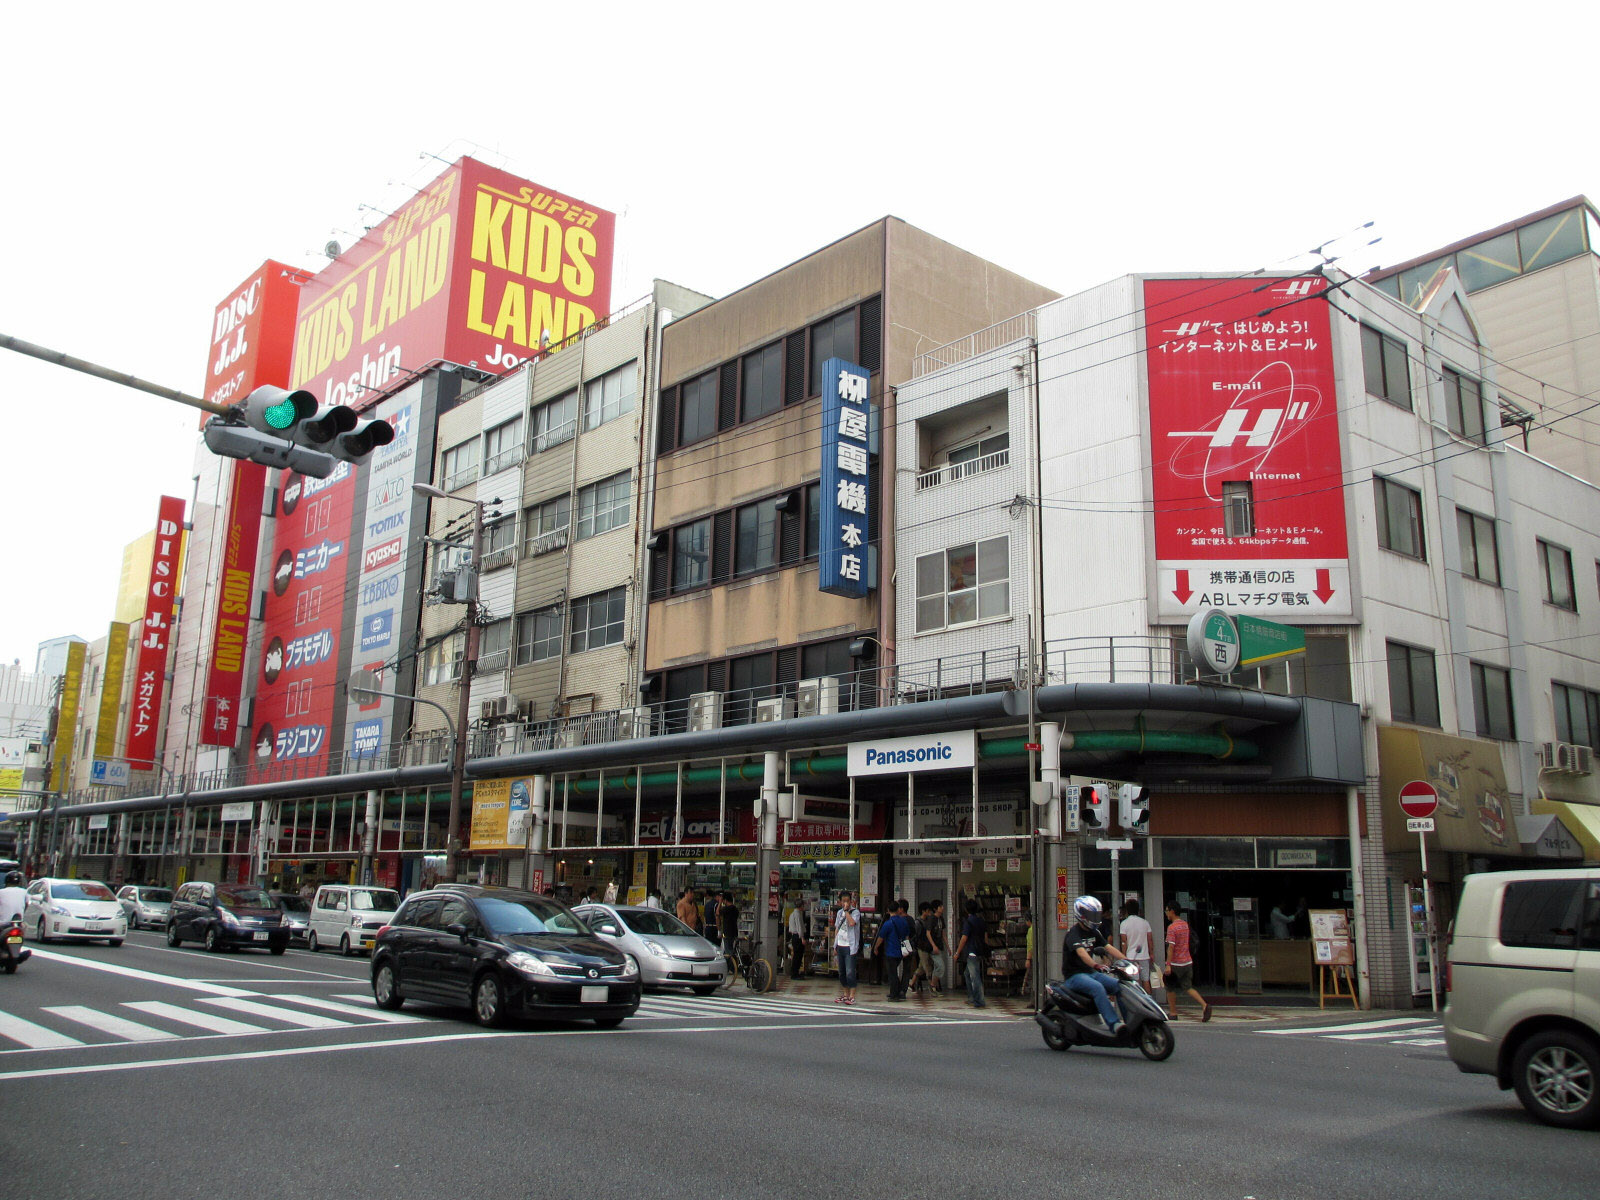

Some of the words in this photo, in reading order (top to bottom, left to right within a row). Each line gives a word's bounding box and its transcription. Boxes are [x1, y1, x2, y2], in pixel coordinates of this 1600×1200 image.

[518, 186, 599, 229] SUPER
[470, 189, 598, 298] KIDS
[212, 276, 262, 346] DISC
[291, 281, 359, 392] KIDS
[360, 212, 452, 346] LAND
[466, 267, 597, 355] LAND
[213, 324, 248, 376] J.J.
[1212, 381, 1262, 391] E-mail
[374, 477, 406, 507] KATO
[1249, 471, 1301, 481] Internet
[369, 510, 406, 538] TOMIX
[152, 519, 178, 598] DISC
[293, 542, 342, 577] ミニカー
[221, 568, 251, 616] KIDS
[363, 573, 399, 606] EBBRO
[1209, 570, 1295, 585] 携帯通信の店
[1199, 591, 1310, 607] ABLマチダ電気
[215, 617, 246, 673] LAND
[285, 630, 332, 670] プラモデル
[1214, 643, 1227, 664] 西
[134, 670, 155, 737] メガストア
[212, 696, 232, 732] 本店
[276, 726, 324, 760] ラジコン
[354, 736, 380, 753] TOMY
[355, 724, 380, 739] TAKARA
[865, 741, 953, 767] Panasonic
